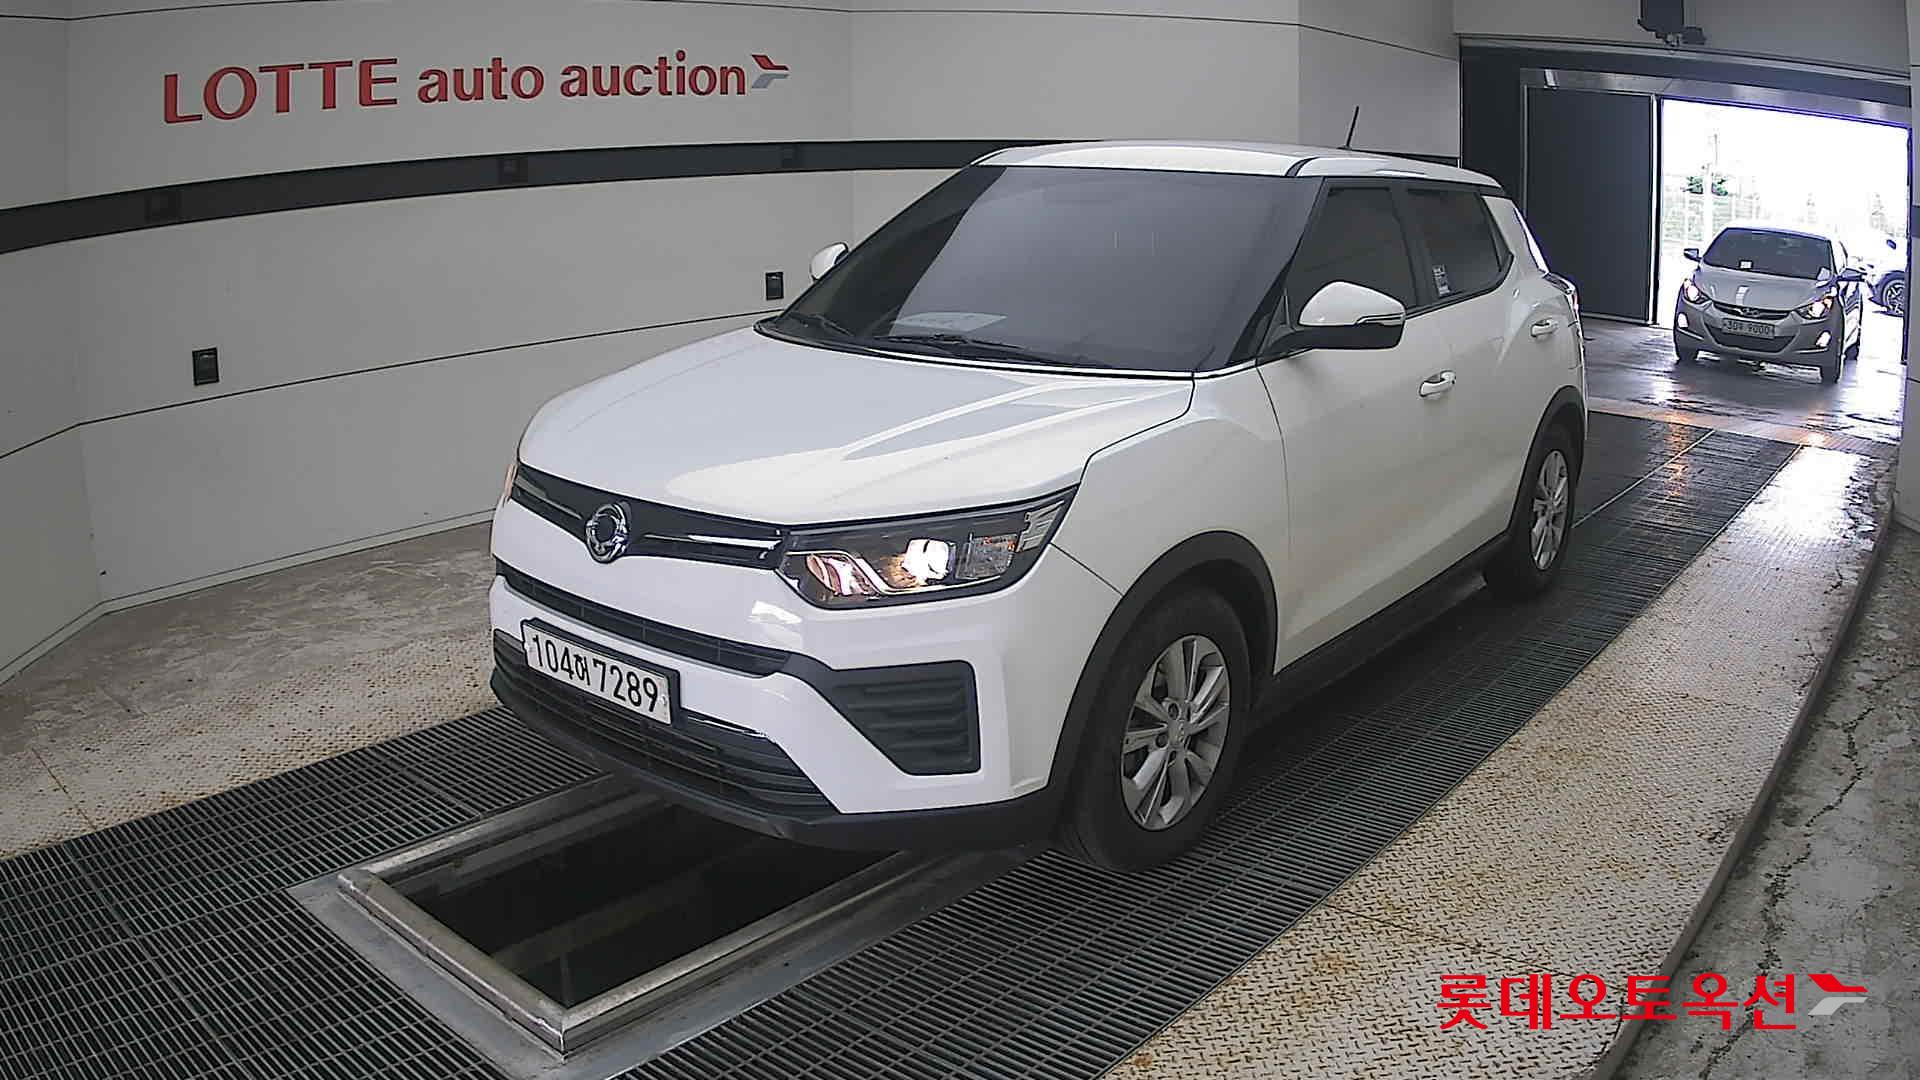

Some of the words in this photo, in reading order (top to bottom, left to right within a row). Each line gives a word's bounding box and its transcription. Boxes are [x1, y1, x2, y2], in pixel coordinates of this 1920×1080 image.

[164, 58, 398, 124] LOTTE
[418, 57, 545, 103] auto
[560, 50, 747, 97] auction
